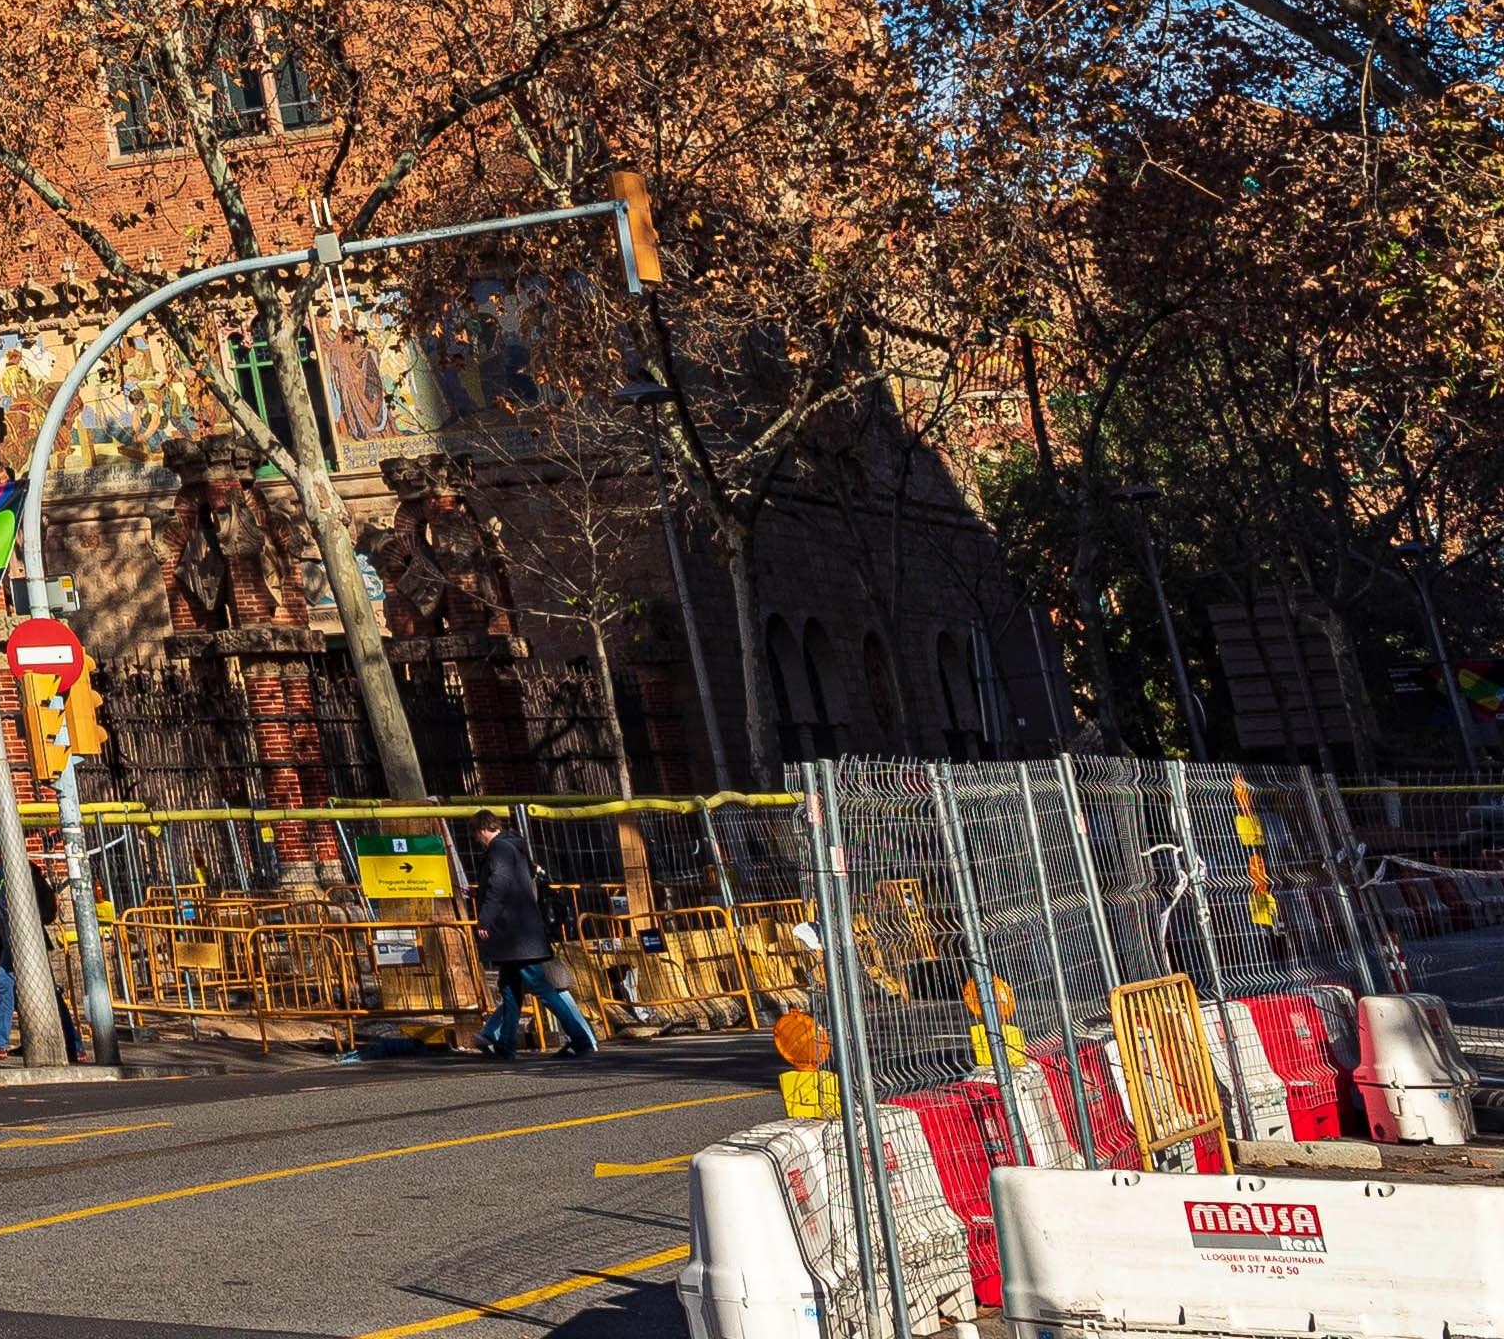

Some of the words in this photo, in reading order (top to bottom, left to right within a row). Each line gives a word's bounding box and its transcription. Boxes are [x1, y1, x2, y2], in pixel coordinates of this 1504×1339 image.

[1279, 1234, 1324, 1252] Rent
[1247, 1254, 1263, 1262] DE
[1230, 1264, 1244, 1273] 93
[1247, 1265, 1266, 1274] 377
[1270, 1265, 1283, 1275] 40
[1286, 1266, 1299, 1275] 50
